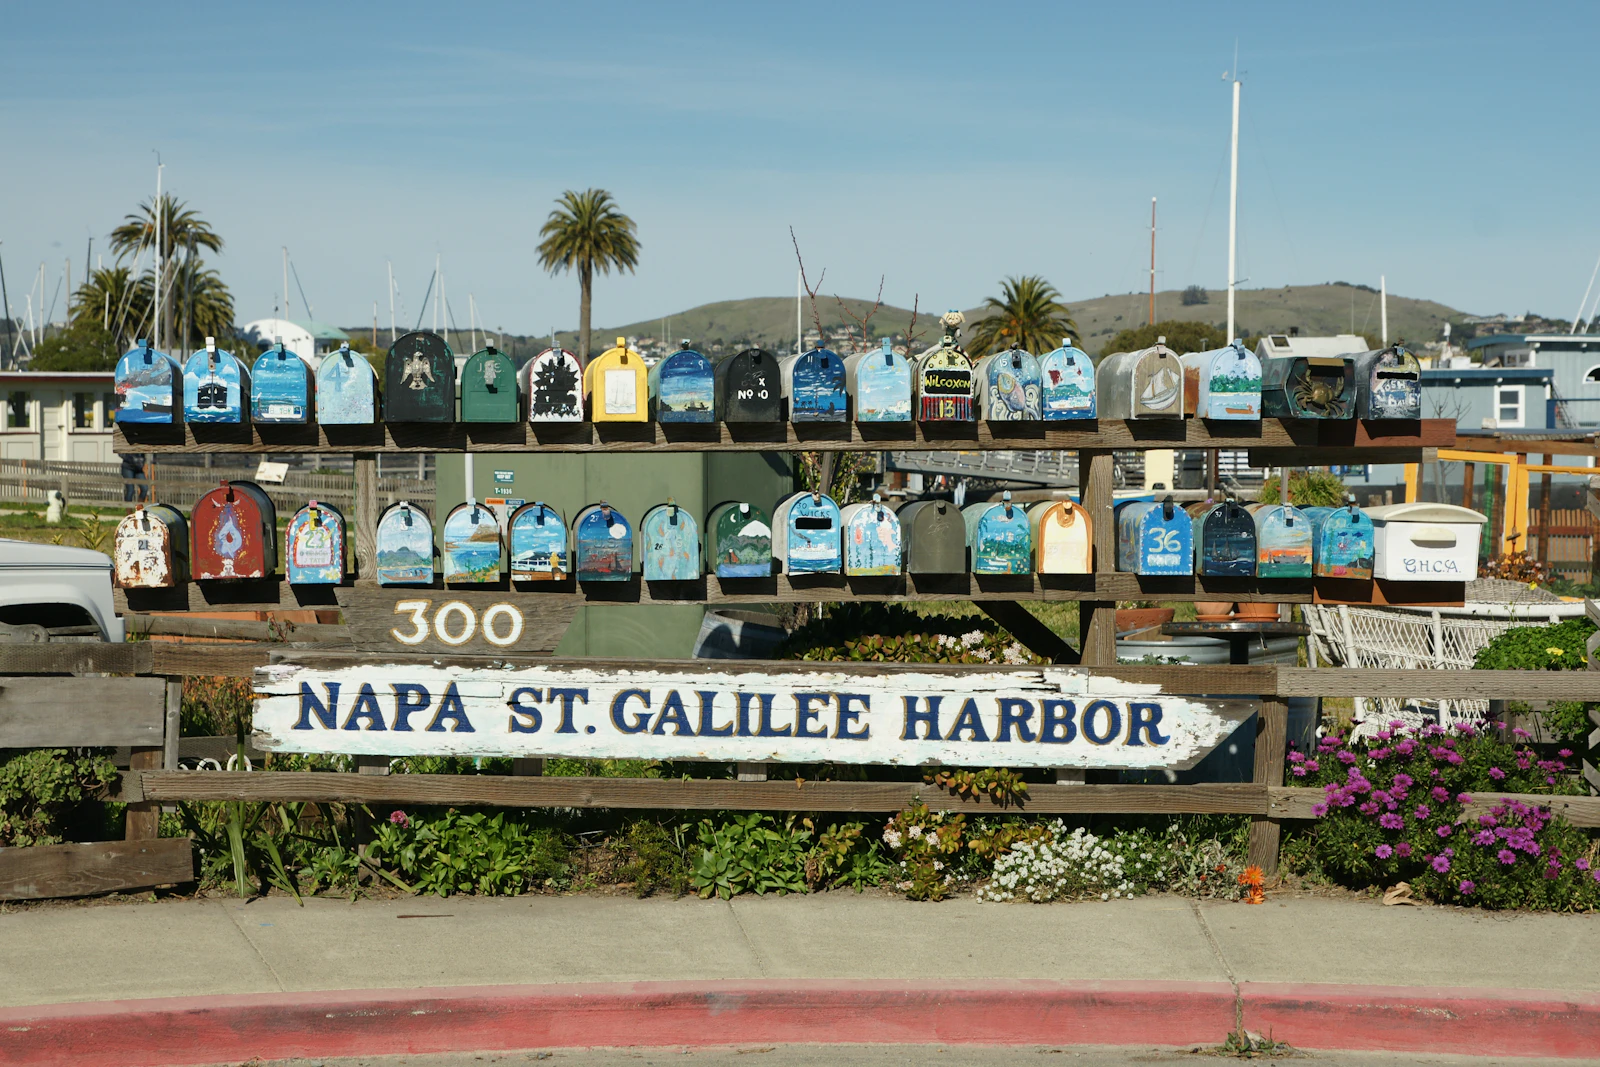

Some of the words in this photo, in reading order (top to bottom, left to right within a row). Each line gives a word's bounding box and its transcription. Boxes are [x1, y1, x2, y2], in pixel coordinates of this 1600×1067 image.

[123, 357, 130, 375] 1
[260, 358, 269, 368] 3
[698, 360, 704, 370] 9
[999, 358, 1008, 367] 15
[324, 362, 349, 392] 4
[939, 399, 956, 418] 13
[800, 509, 830, 519] WICKS
[304, 529, 325, 549] 23
[1148, 527, 1182, 553] 36
[390, 598, 526, 647] 300
[291, 680, 476, 733] NAPA
[508, 686, 596, 734] ST.
[609, 688, 871, 740] GALILEE
[899, 695, 1171, 747] HARBOR
